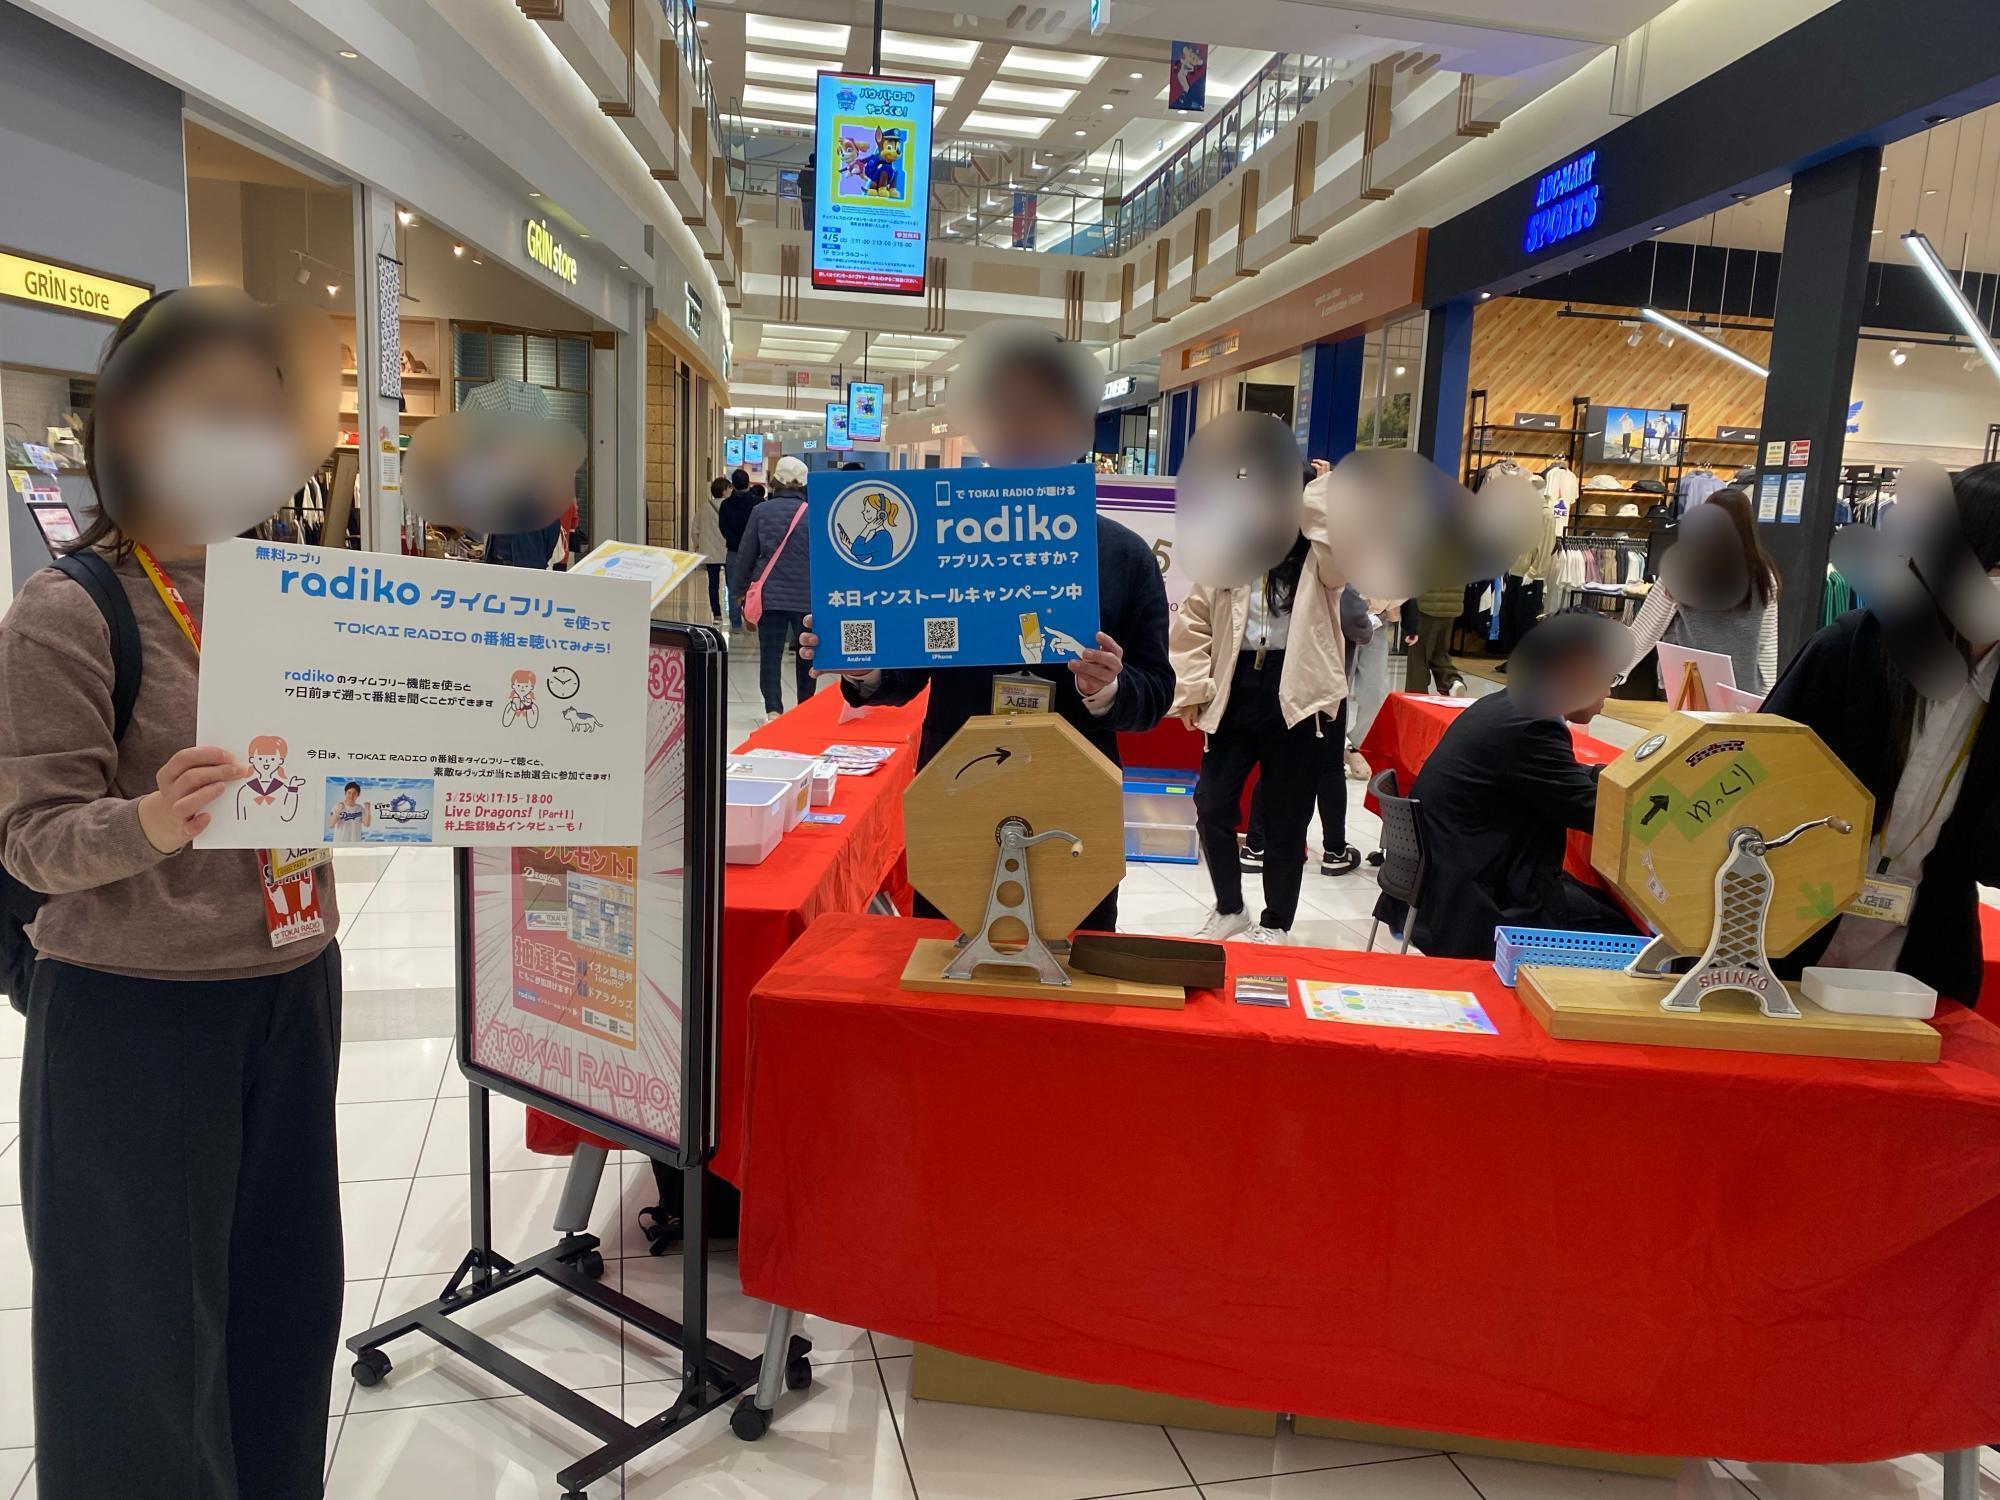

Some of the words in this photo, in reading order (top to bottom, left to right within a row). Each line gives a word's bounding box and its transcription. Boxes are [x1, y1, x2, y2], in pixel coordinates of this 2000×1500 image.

[1536, 150, 1596, 207] ABC-MART
[1527, 184, 1599, 253] SPORTS
[552, 242, 577, 285] store
[24, 269, 67, 303] GRiN
[69, 284, 110, 312] store
[955, 490, 965, 500] で
[969, 488, 999, 499] TOKAI
[1002, 487, 1034, 498] RADIO
[1036, 485, 1076, 497] が聴ける
[936, 504, 1078, 544] radiko
[255, 545, 321, 565] 無料アプリ
[937, 550, 1080, 569] アプリ入ってますか？
[281, 566, 421, 606] radiko
[430, 589, 577, 618] タイムフリー
[827, 583, 1083, 608] 本日インストールキャンペーン中
[563, 615, 611, 632] を使って
[334, 621, 399, 638] TOKAI
[403, 627, 467, 643] RADIO
[471, 630, 611, 654] の番組を聴いてみよう！
[847, 655, 871, 663] Android
[284, 668, 334, 684] radiko
[337, 674, 472, 693] のタイムフリー機能を使うと
[1004, 695, 1040, 709] 入店証
[347, 752, 386, 761] TOKAI
[389, 754, 428, 763] RADIO
[1686, 763, 1755, 823] ゆっくり
[445, 805, 471, 818] Live
[475, 805, 532, 820] Dragons!
[444, 820, 584, 832] 井上監督独占インタビューも！
[281, 926, 300, 937] TOKAI
[301, 921, 320, 932] RADIO
[514, 935, 576, 986] 抽選会
[1699, 968, 1769, 991] SHINKO
[488, 1018, 571, 1078] TOKAI
[578, 1052, 669, 1112] RADIO
